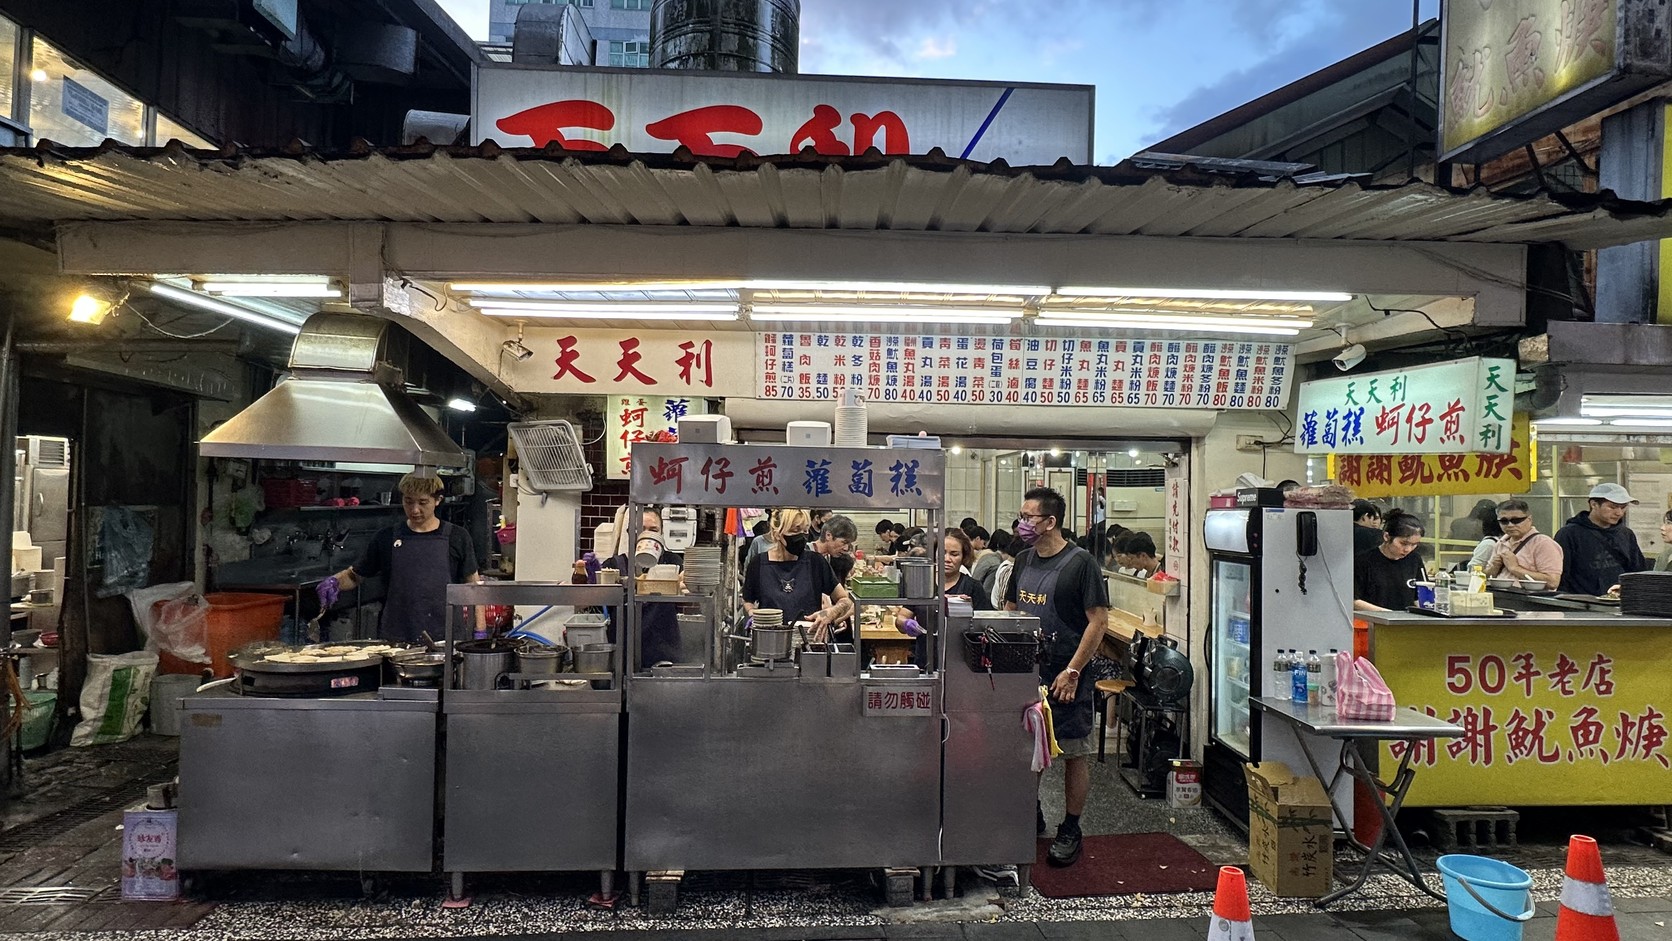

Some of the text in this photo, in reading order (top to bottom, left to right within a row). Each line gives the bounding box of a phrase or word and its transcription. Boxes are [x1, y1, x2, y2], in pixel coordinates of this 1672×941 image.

[551, 336, 714, 388] 天天利
[799, 334, 811, 398] 魯肉飯 35
[816, 335, 829, 398] 乾麵 50
[833, 335, 846, 398] 乾米粉 5
[851, 336, 864, 386] 乾冬粉
[919, 337, 934, 401] 貢丸湯 40
[937, 338, 951, 401] 青菜湯 50
[953, 338, 968, 402] 蛋花湯 40
[972, 338, 986, 402] 燙青菜 50
[1005, 339, 1021, 402] 筍絲滷 40
[1023, 339, 1039, 403] 油豆腐 40
[1040, 340, 1057, 403] 切仔麵 50
[1057, 340, 1074, 403] 切仔米粉 50
[1075, 340, 1091, 403] 魚丸麵 65
[1093, 340, 1109, 403] 魚丸米粉 65
[1111, 341, 1127, 404] 貢丸麵 65
[1128, 341, 1145, 404] 貢丸米粉 65
[765, 385, 777, 397] 85
[781, 386, 794, 398] 70
[868, 388, 880, 399] 70
[885, 389, 897, 400] 80
[901, 389, 916, 400] 40
[989, 391, 1002, 402] 30
[1145, 393, 1156, 405] 70
[1163, 394, 1174, 405] 70
[1179, 393, 1191, 405] 70
[1197, 394, 1209, 405] 70
[1213, 394, 1226, 406] 80
[1230, 396, 1244, 407] 80
[1248, 396, 1261, 407] 80
[1265, 396, 1279, 407] 80
[1344, 375, 1407, 406] 天天利
[1478, 366, 1509, 450] 天天利
[1300, 398, 1466, 449] 蘿蔔糕 蚵仔煎
[649, 456, 922, 499] 蚵仔煎 蘿蔔糕
[1237, 492, 1257, 505] Supreme
[1019, 590, 1047, 605] 天天利
[1447, 653, 1615, 697] 50年老店
[868, 692, 930, 709] 請勿觸碰
